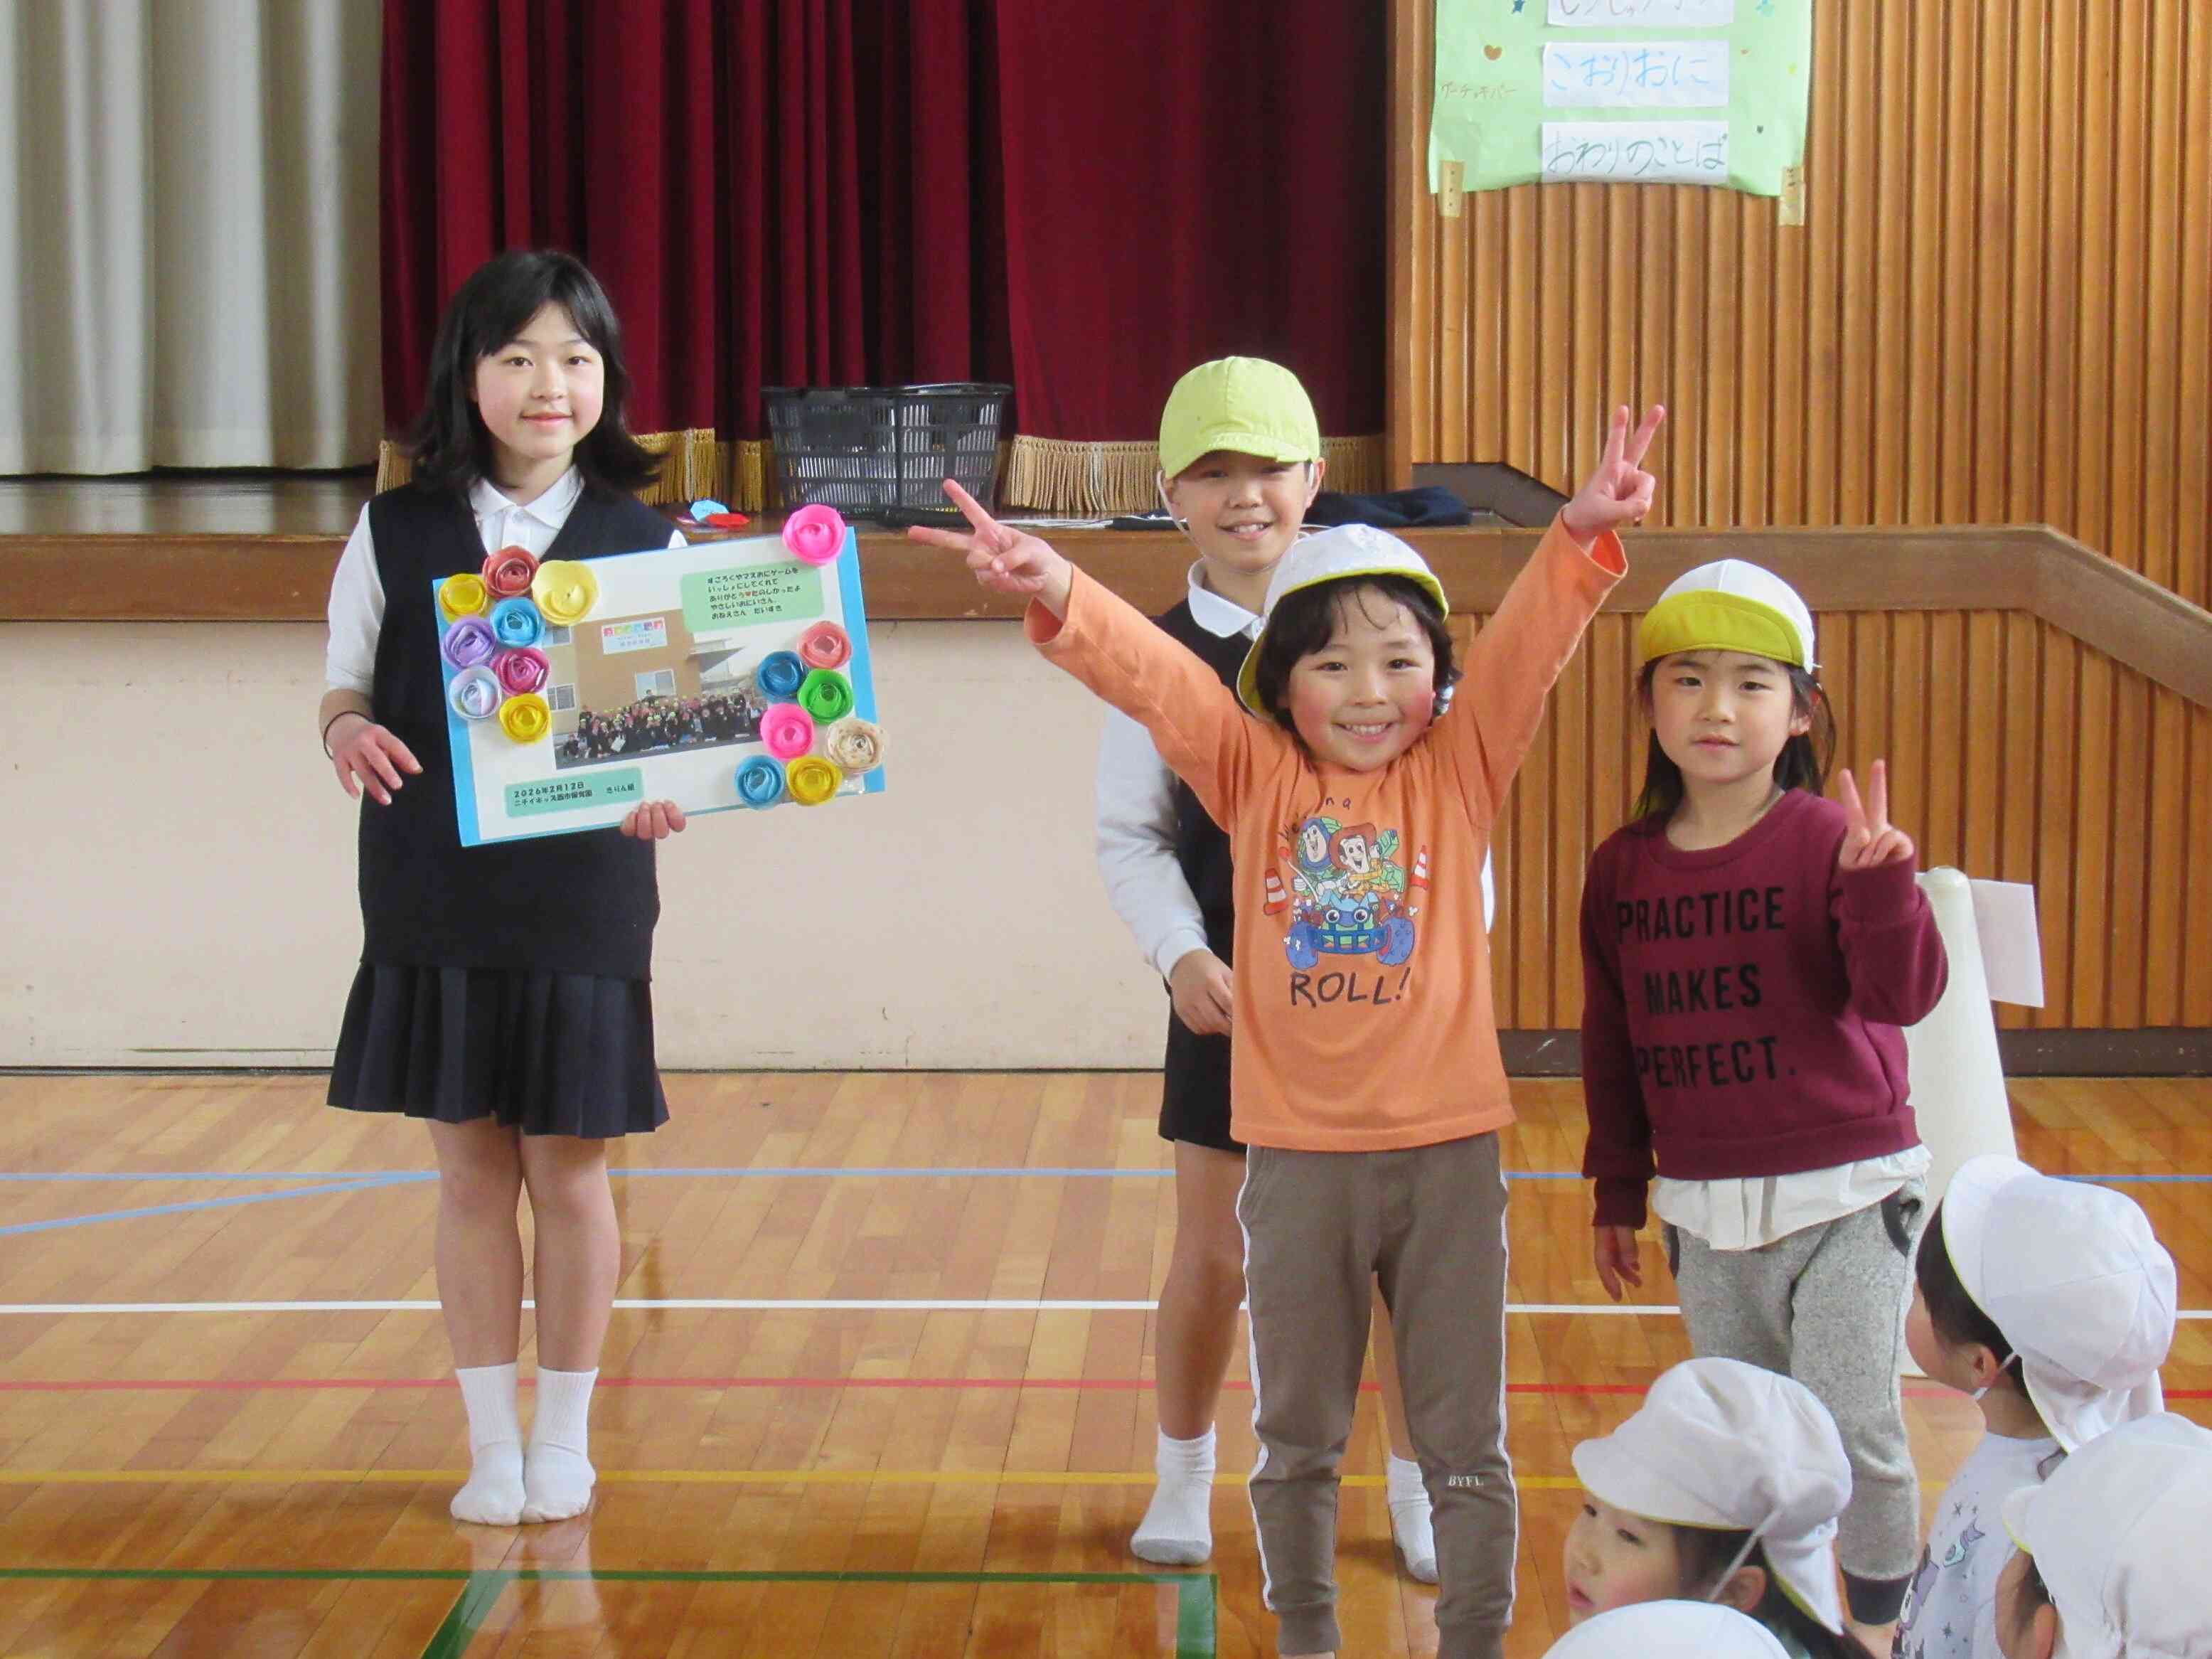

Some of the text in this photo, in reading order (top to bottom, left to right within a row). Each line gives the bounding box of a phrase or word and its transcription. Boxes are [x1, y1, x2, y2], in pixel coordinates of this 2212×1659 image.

[1550, 48, 1711, 95] こおりおに
[1545, 131, 1729, 176] おわりのことば
[1615, 887, 1786, 944] PRACTICE
[1290, 967, 1411, 1008] ROLL!
[1643, 963, 1762, 1014] MAKES
[1637, 1035, 1797, 1089] PERFECT.
